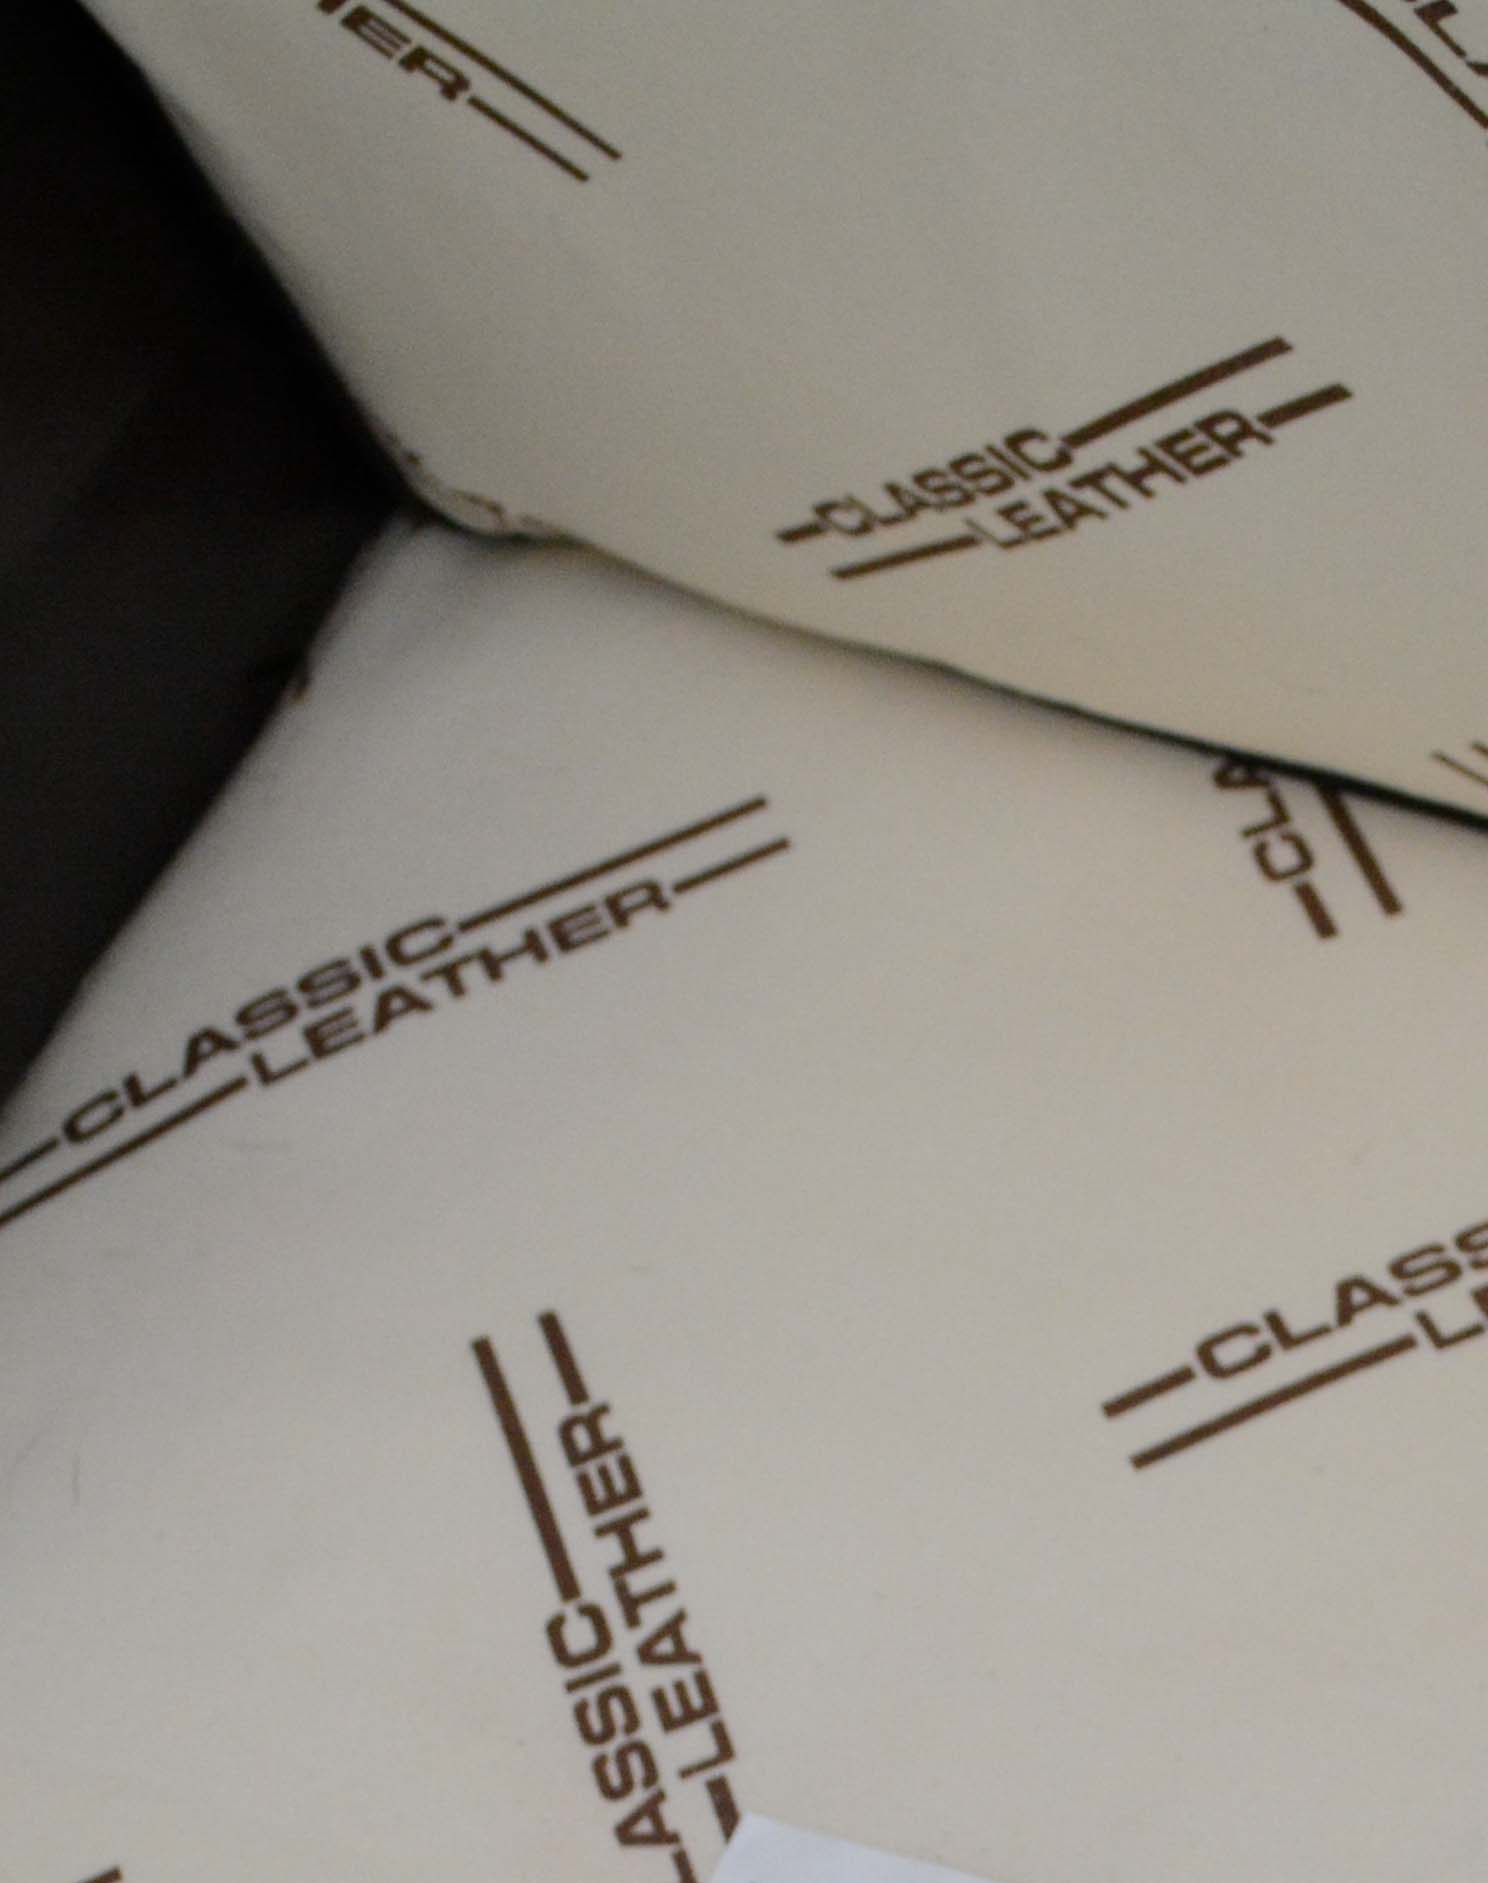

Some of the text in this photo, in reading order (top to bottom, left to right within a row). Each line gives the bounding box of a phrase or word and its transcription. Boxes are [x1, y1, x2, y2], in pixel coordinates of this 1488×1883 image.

[812, 428, 1072, 537] CLASSIC
[965, 408, 1278, 551] LEATHER
[59, 916, 460, 1148] CLASSIC
[245, 878, 674, 1087] LEATHER
[557, 1400, 738, 1780] LEATHER
